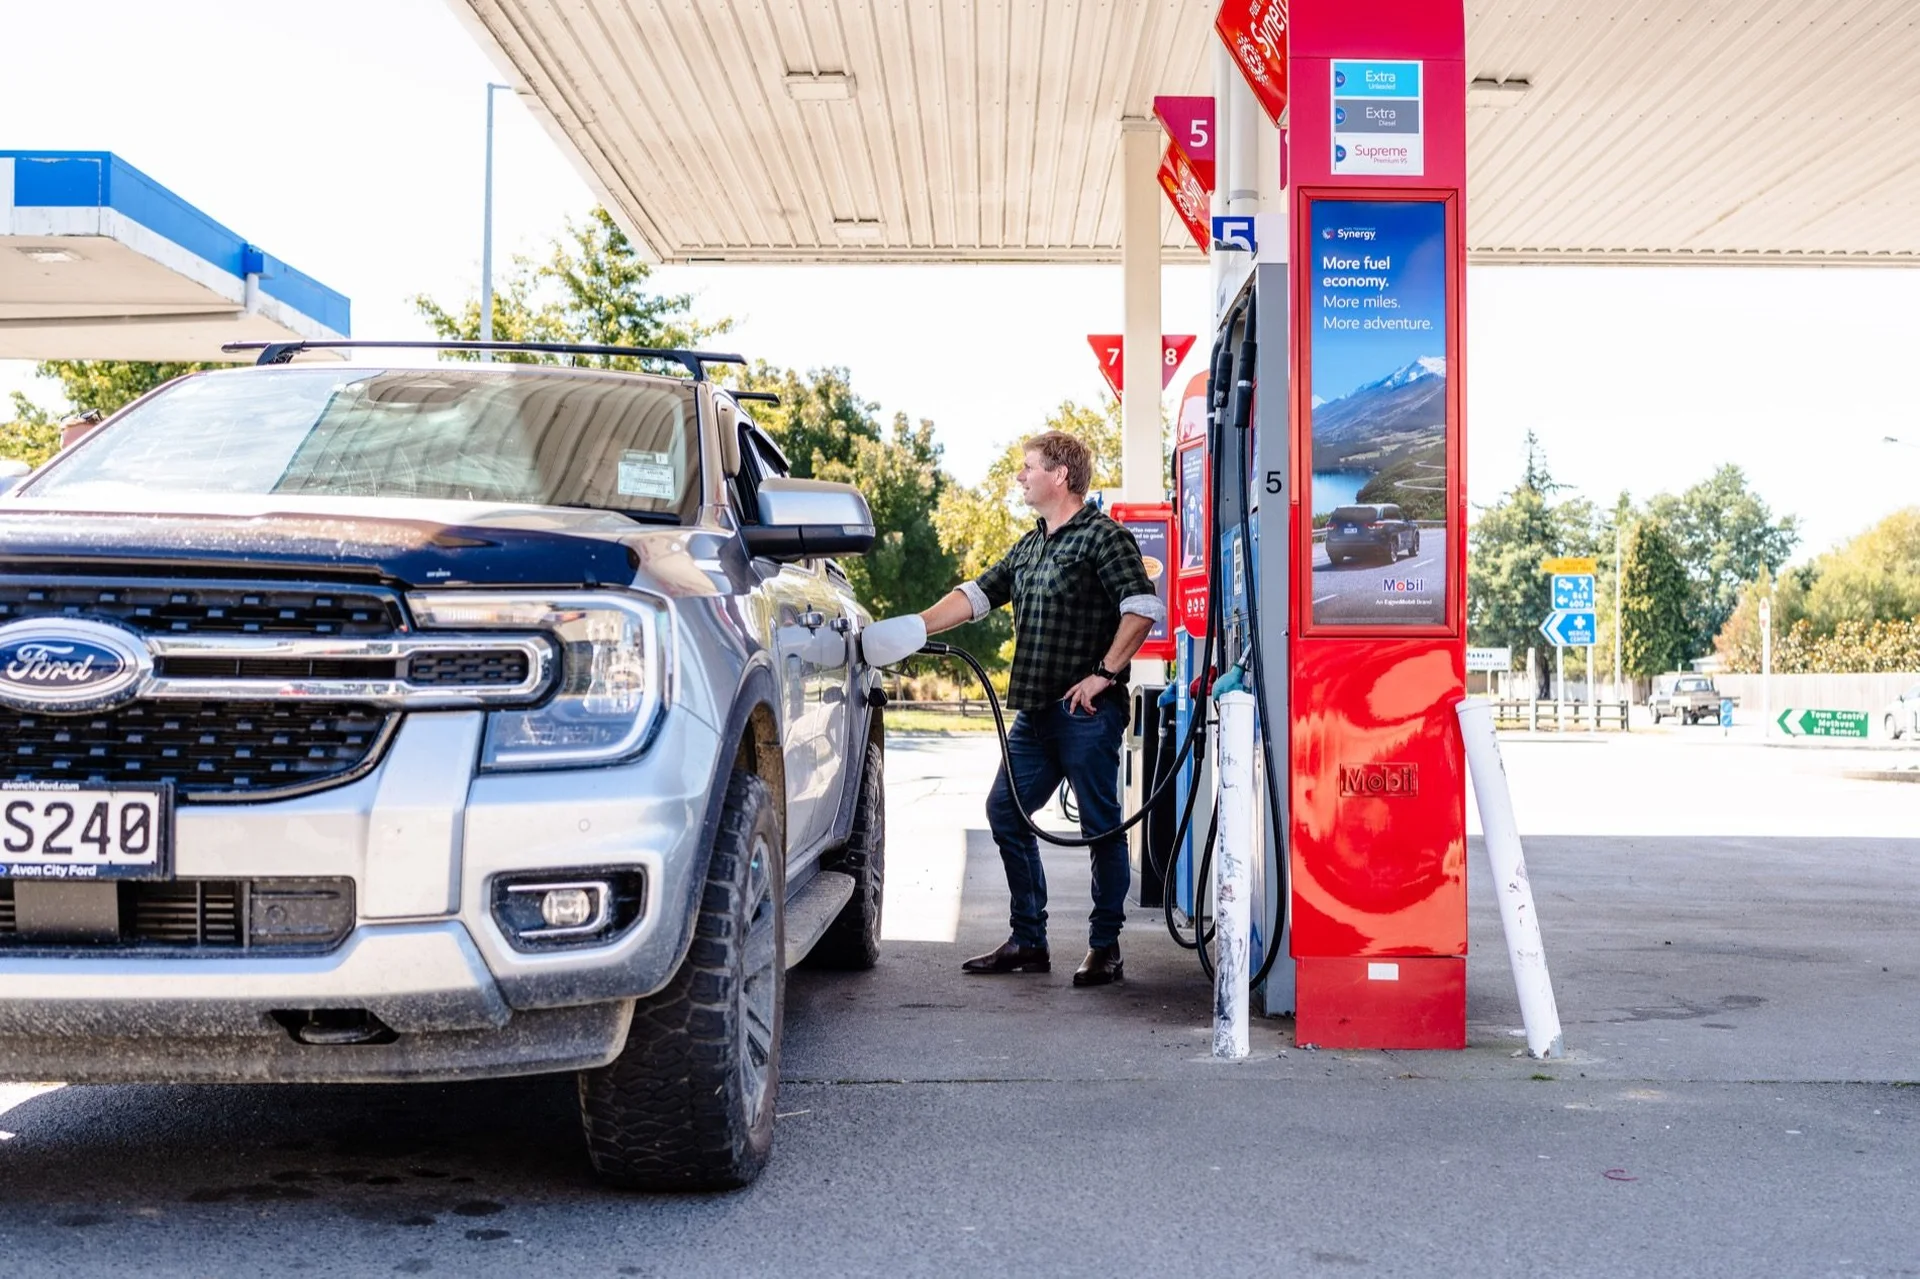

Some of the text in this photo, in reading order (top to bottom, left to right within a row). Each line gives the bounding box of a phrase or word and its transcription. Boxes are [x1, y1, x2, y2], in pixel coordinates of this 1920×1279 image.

[1365, 70, 1396, 83] Extra
[1365, 107, 1396, 119] Extra
[1190, 120, 1208, 147] 5
[1354, 144, 1407, 159] Supreme
[1222, 221, 1252, 251] 5
[1337, 228, 1376, 241] Synergy
[1322, 256, 1391, 270] More fuel
[1322, 277, 1389, 291] economy.
[1323, 295, 1401, 308] More miles.
[1323, 316, 1433, 330] More adventure.
[1107, 348, 1120, 366] 7
[1165, 348, 1177, 365] 8
[1265, 471, 1282, 494] 5
[1383, 579, 1424, 591] Mobil
[6, 643, 95, 682] Ford
[1810, 711, 1865, 720] Town Centre
[2, 781, 80, 792] avoncityford.com
[1342, 767, 1413, 792] Mobil
[4, 800, 150, 855] S240
[10, 864, 97, 877] Avon City Ford
